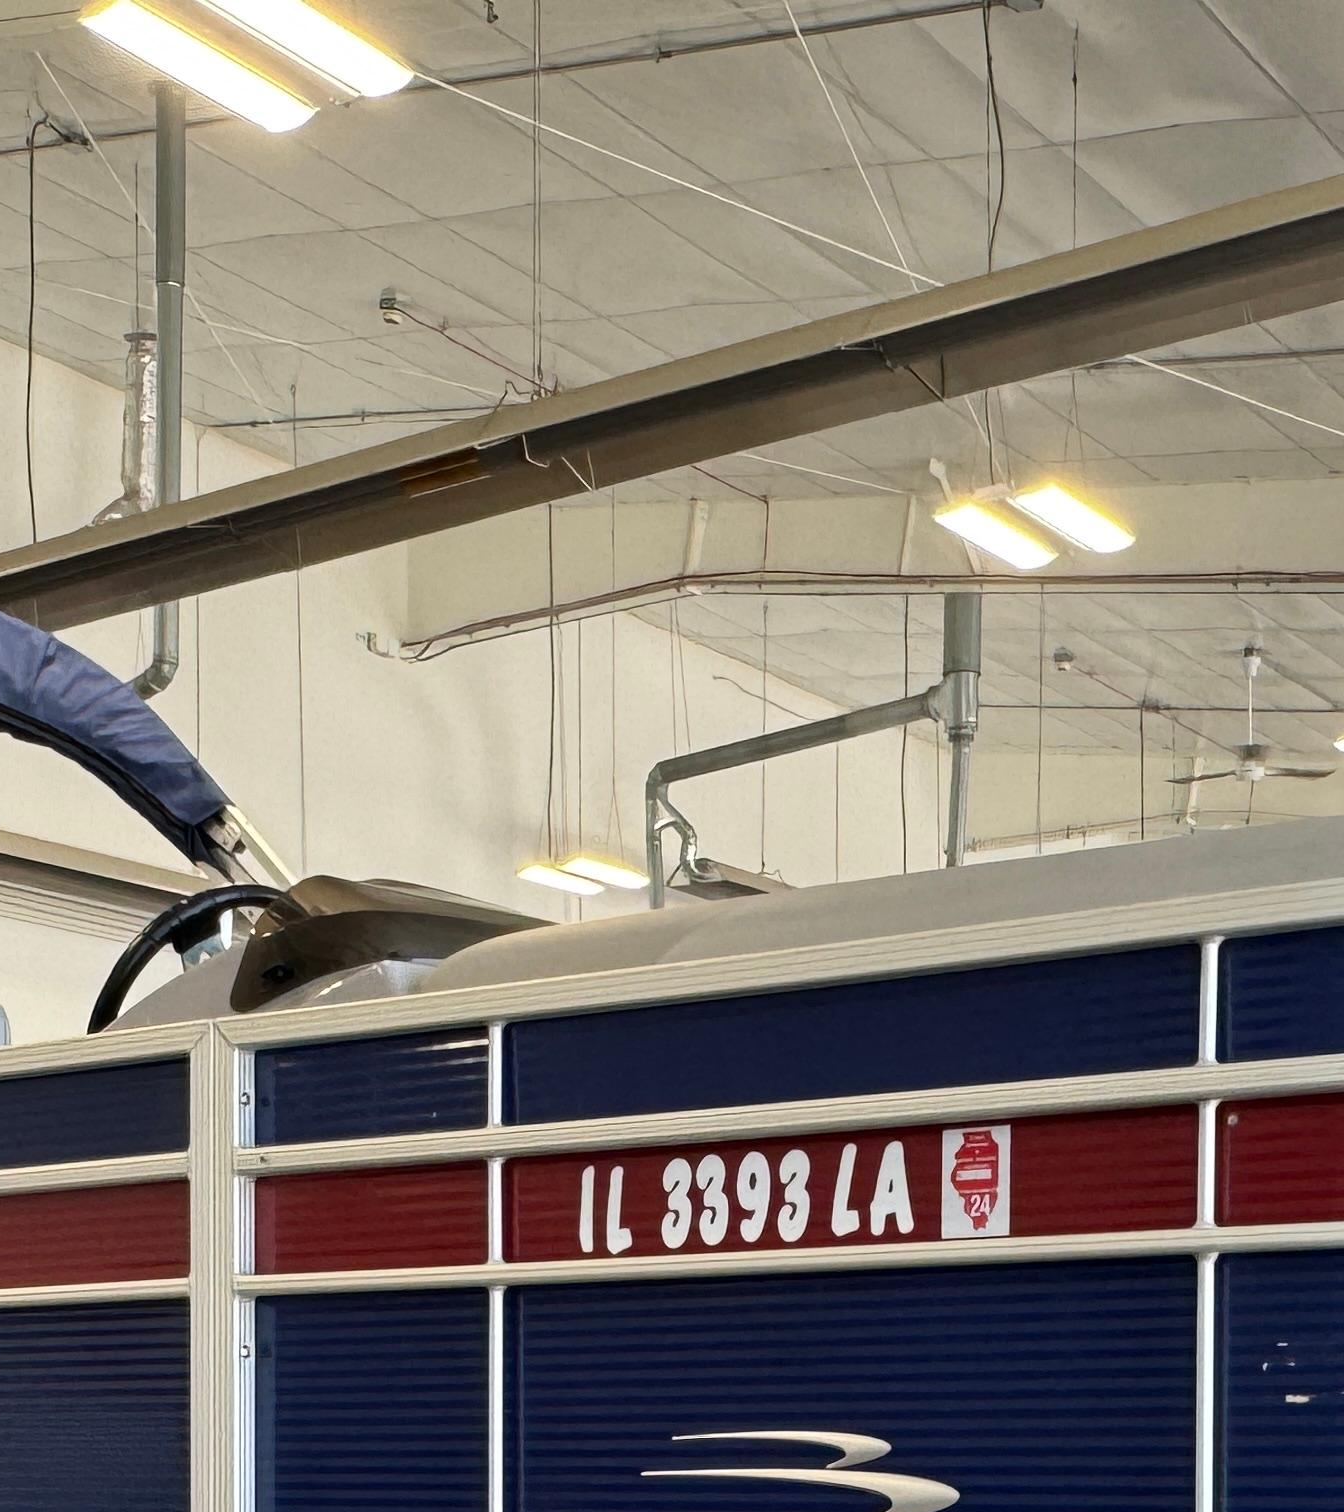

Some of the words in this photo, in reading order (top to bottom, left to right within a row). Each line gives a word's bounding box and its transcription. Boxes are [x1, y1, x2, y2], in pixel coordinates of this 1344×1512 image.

[578, 1164, 633, 1255] IL
[660, 1149, 812, 1249] 3393
[830, 1140, 915, 1237] LA
[970, 1194, 990, 1217] 24
